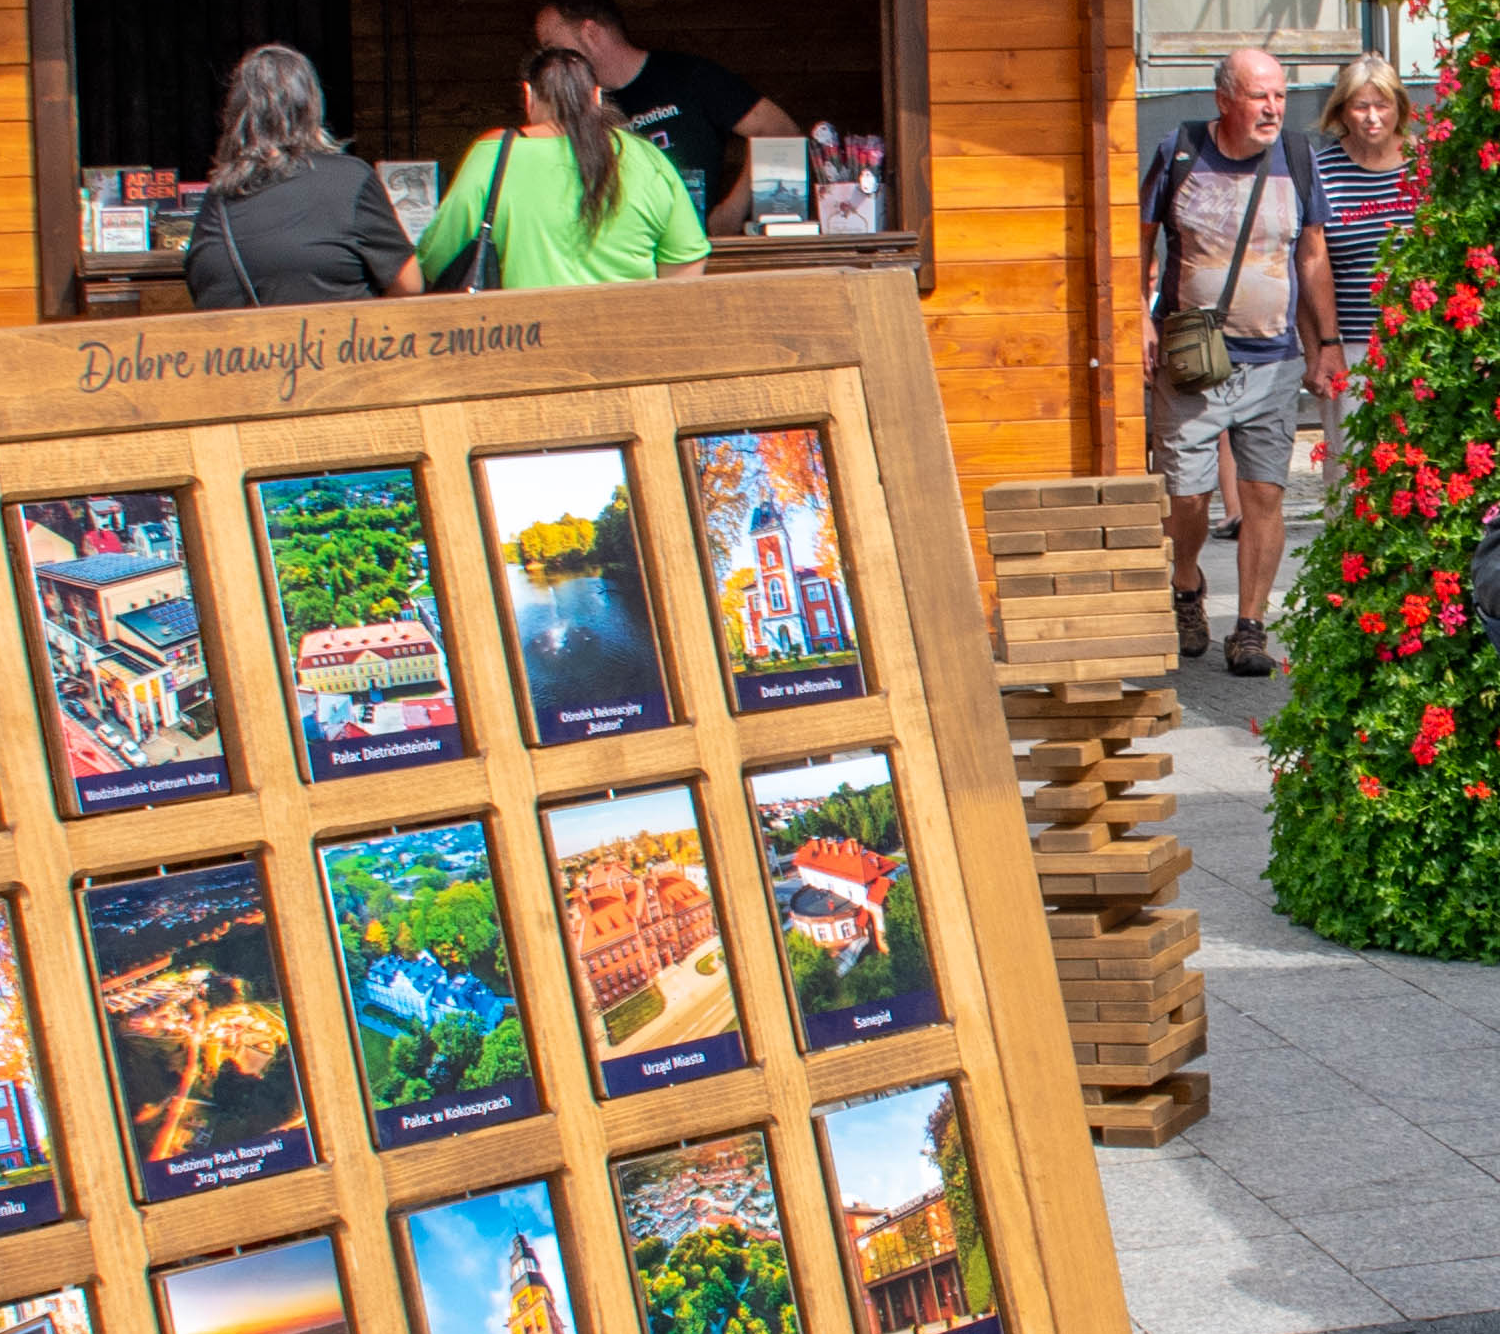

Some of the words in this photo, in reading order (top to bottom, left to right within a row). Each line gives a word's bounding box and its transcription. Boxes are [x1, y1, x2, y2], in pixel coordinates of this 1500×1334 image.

[626, 104, 680, 132] yStation
[125, 171, 176, 187] ADLER
[125, 186, 176, 200] OLSEN
[78, 332, 195, 393] Dobre
[203, 318, 326, 402] nawyki
[336, 317, 418, 365] duża
[428, 316, 542, 358] zmiana
[760, 684, 784, 699] Dwór
[362, 737, 442, 762] Dietrichsteinów
[149, 777, 188, 793] Centrum
[187, 771, 220, 787] Kultury
[852, 1009, 893, 1030] Sanepid
[642, 1057, 672, 1076] Urząd
[671, 1051, 706, 1069] Miasta
[433, 1111, 444, 1123] w
[443, 1094, 512, 1120] Kokoszycach
[168, 1156, 214, 1175] Rodzinny
[213, 1149, 238, 1166] Park
[237, 1139, 284, 1161] Rozrywki
